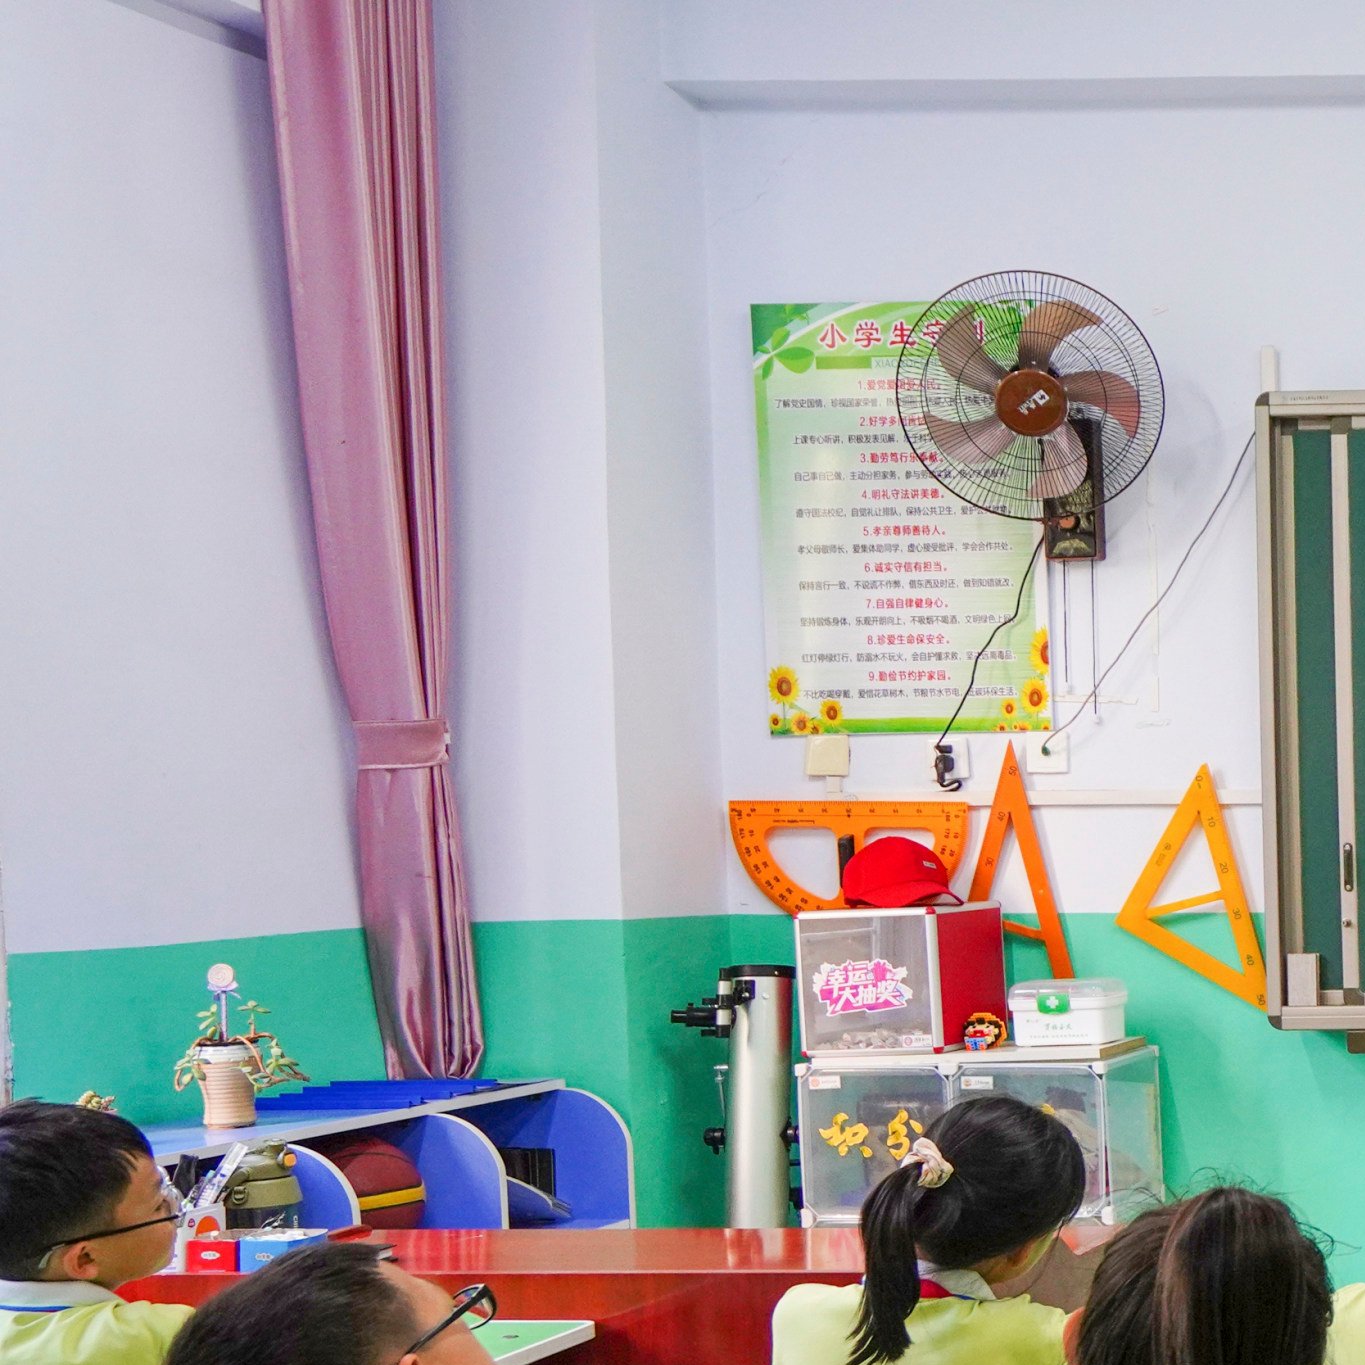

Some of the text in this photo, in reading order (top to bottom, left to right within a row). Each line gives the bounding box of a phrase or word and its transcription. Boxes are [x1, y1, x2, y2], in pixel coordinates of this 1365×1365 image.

[818, 319, 985, 350] 小学生守
[823, 964, 874, 998] 幸运
[834, 980, 903, 1012] 大抽奖
